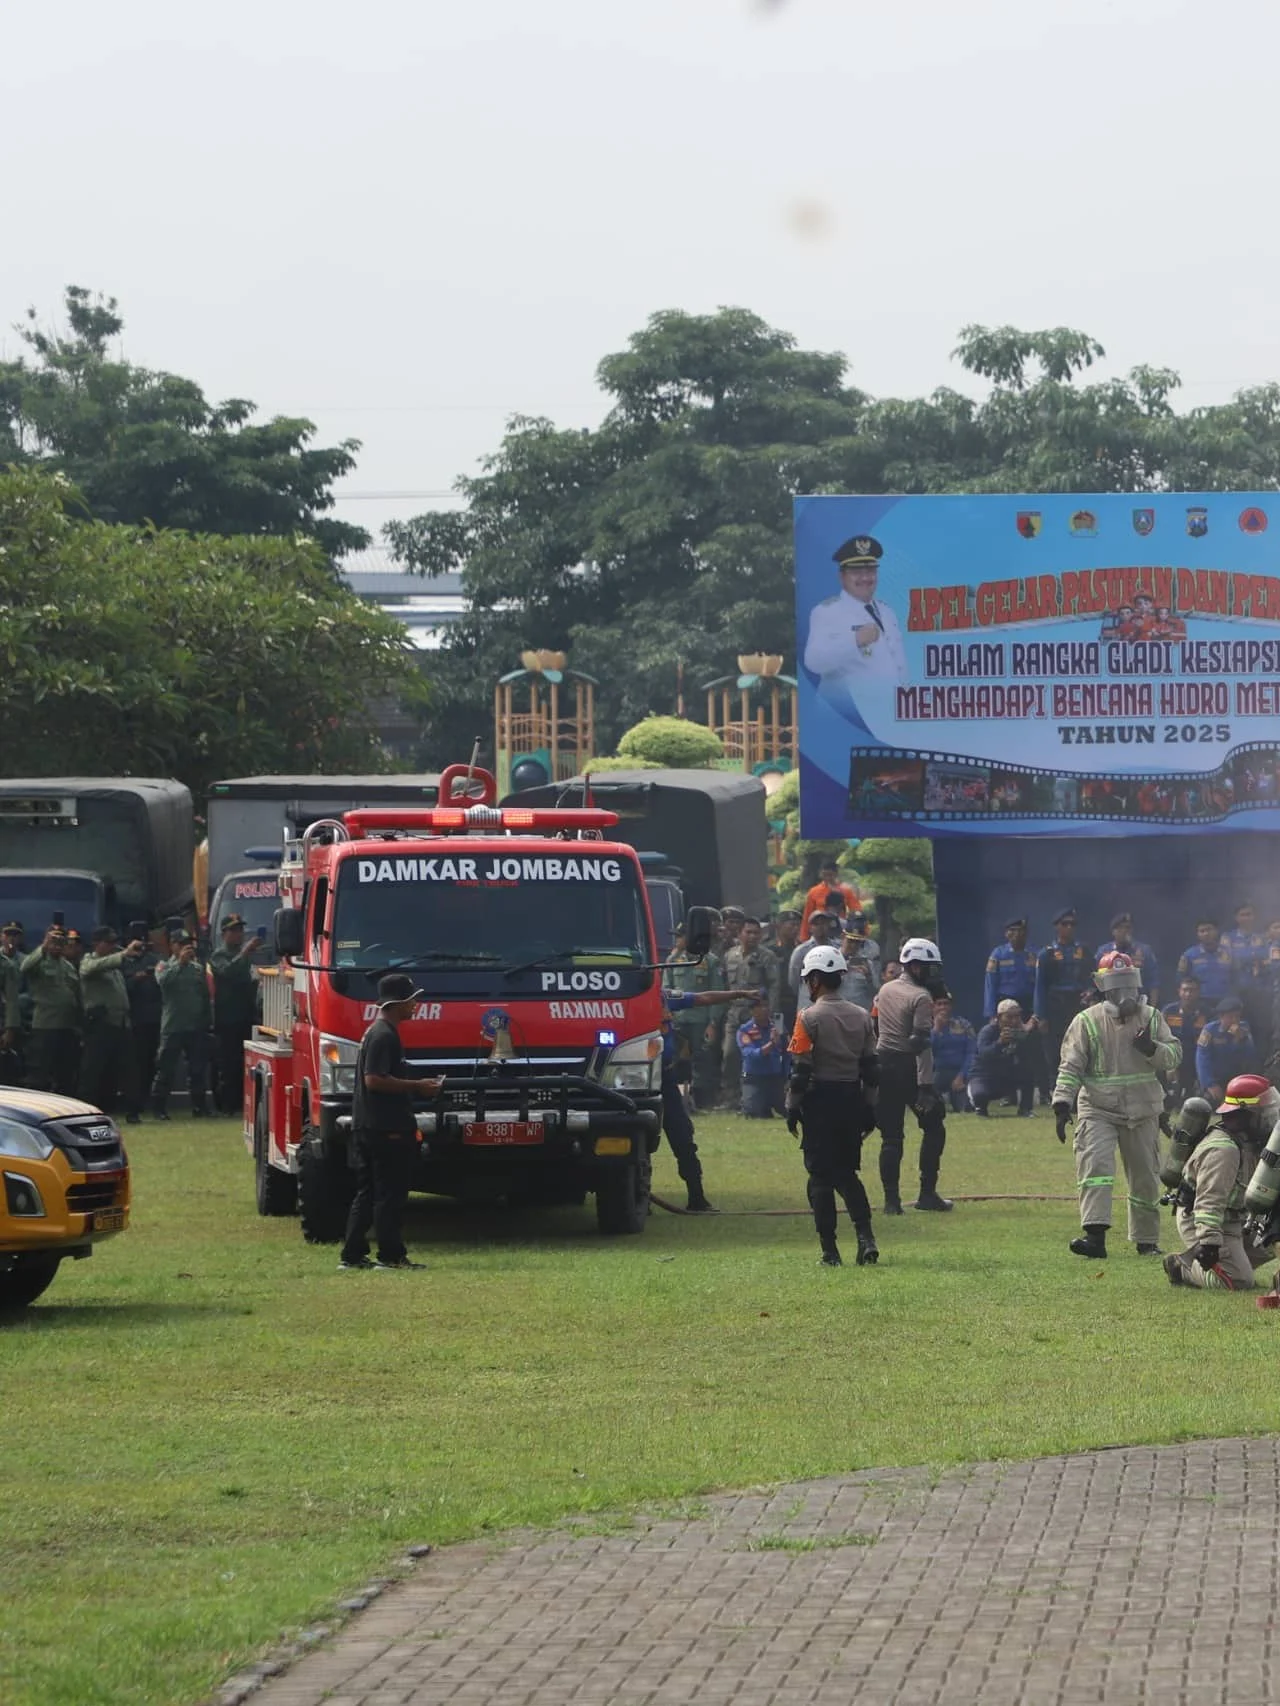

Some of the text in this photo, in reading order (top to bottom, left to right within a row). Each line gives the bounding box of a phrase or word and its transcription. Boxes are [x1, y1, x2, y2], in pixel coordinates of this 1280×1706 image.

[907, 585, 973, 632] APEL
[975, 574, 1058, 626] GELAR
[1060, 567, 1173, 615] PASUKAN
[1176, 567, 1229, 616] DAN
[926, 643, 1004, 677] DALAM
[1012, 642, 1100, 676] RANGKA
[1107, 641, 1173, 675] GLADI
[896, 684, 1046, 719] MENGHADAPI
[1053, 683, 1152, 717] BENCANA
[1160, 682, 1229, 715] HIDRO
[1058, 724, 1231, 744] TAHUN 2025
[358, 858, 621, 883] DAMKAR JOMBANG
[235, 881, 277, 899] POLISI
[541, 971, 622, 991] PLOSO
[465, 1122, 542, 1137] S 8381 WP
